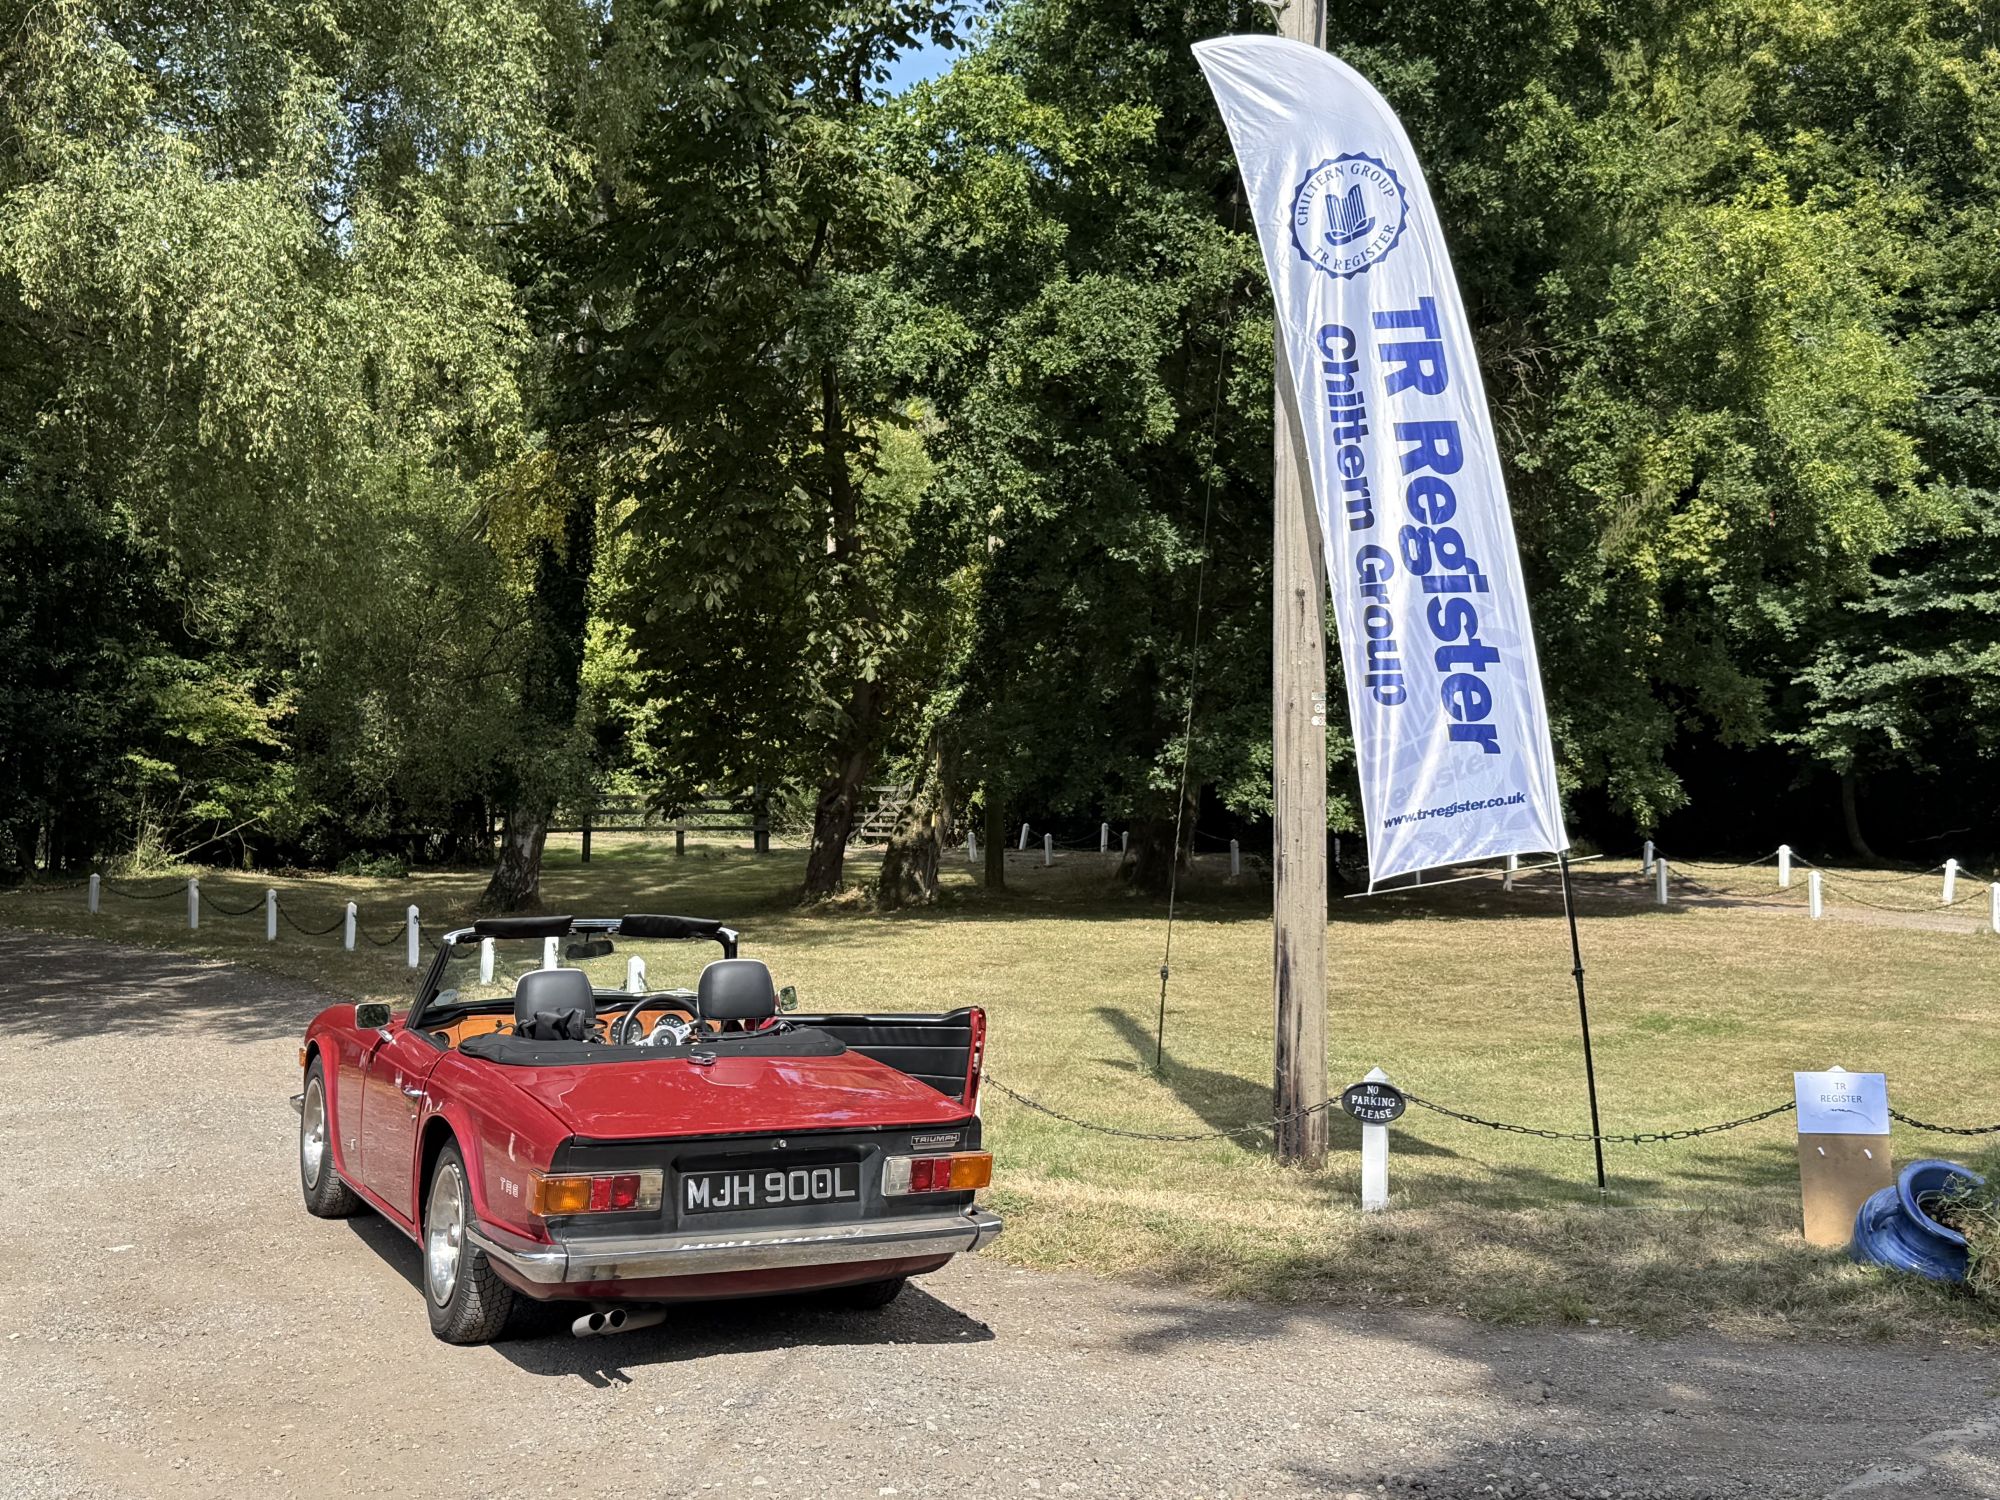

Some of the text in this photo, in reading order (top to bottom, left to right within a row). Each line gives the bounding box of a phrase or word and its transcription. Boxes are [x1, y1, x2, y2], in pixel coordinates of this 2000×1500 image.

[1297, 162, 1395, 226] CHILTERN GROUP
[1312, 224, 1396, 271] TR REGISTER
[1316, 323, 1407, 706] Chiltern Group
[1372, 296, 1501, 754] TR Register
[1383, 791, 1526, 829] www.tr-register.co.uk
[1366, 1085, 1379, 1094] NO
[1820, 1094, 1863, 1104] REGISTER
[1834, 1082, 1847, 1091] TR
[1351, 1095, 1396, 1107] PARKING
[1353, 1106, 1393, 1119] PLEASE
[913, 1134, 959, 1144] TRIUMPH
[687, 1167, 856, 1210] MJH 900L
